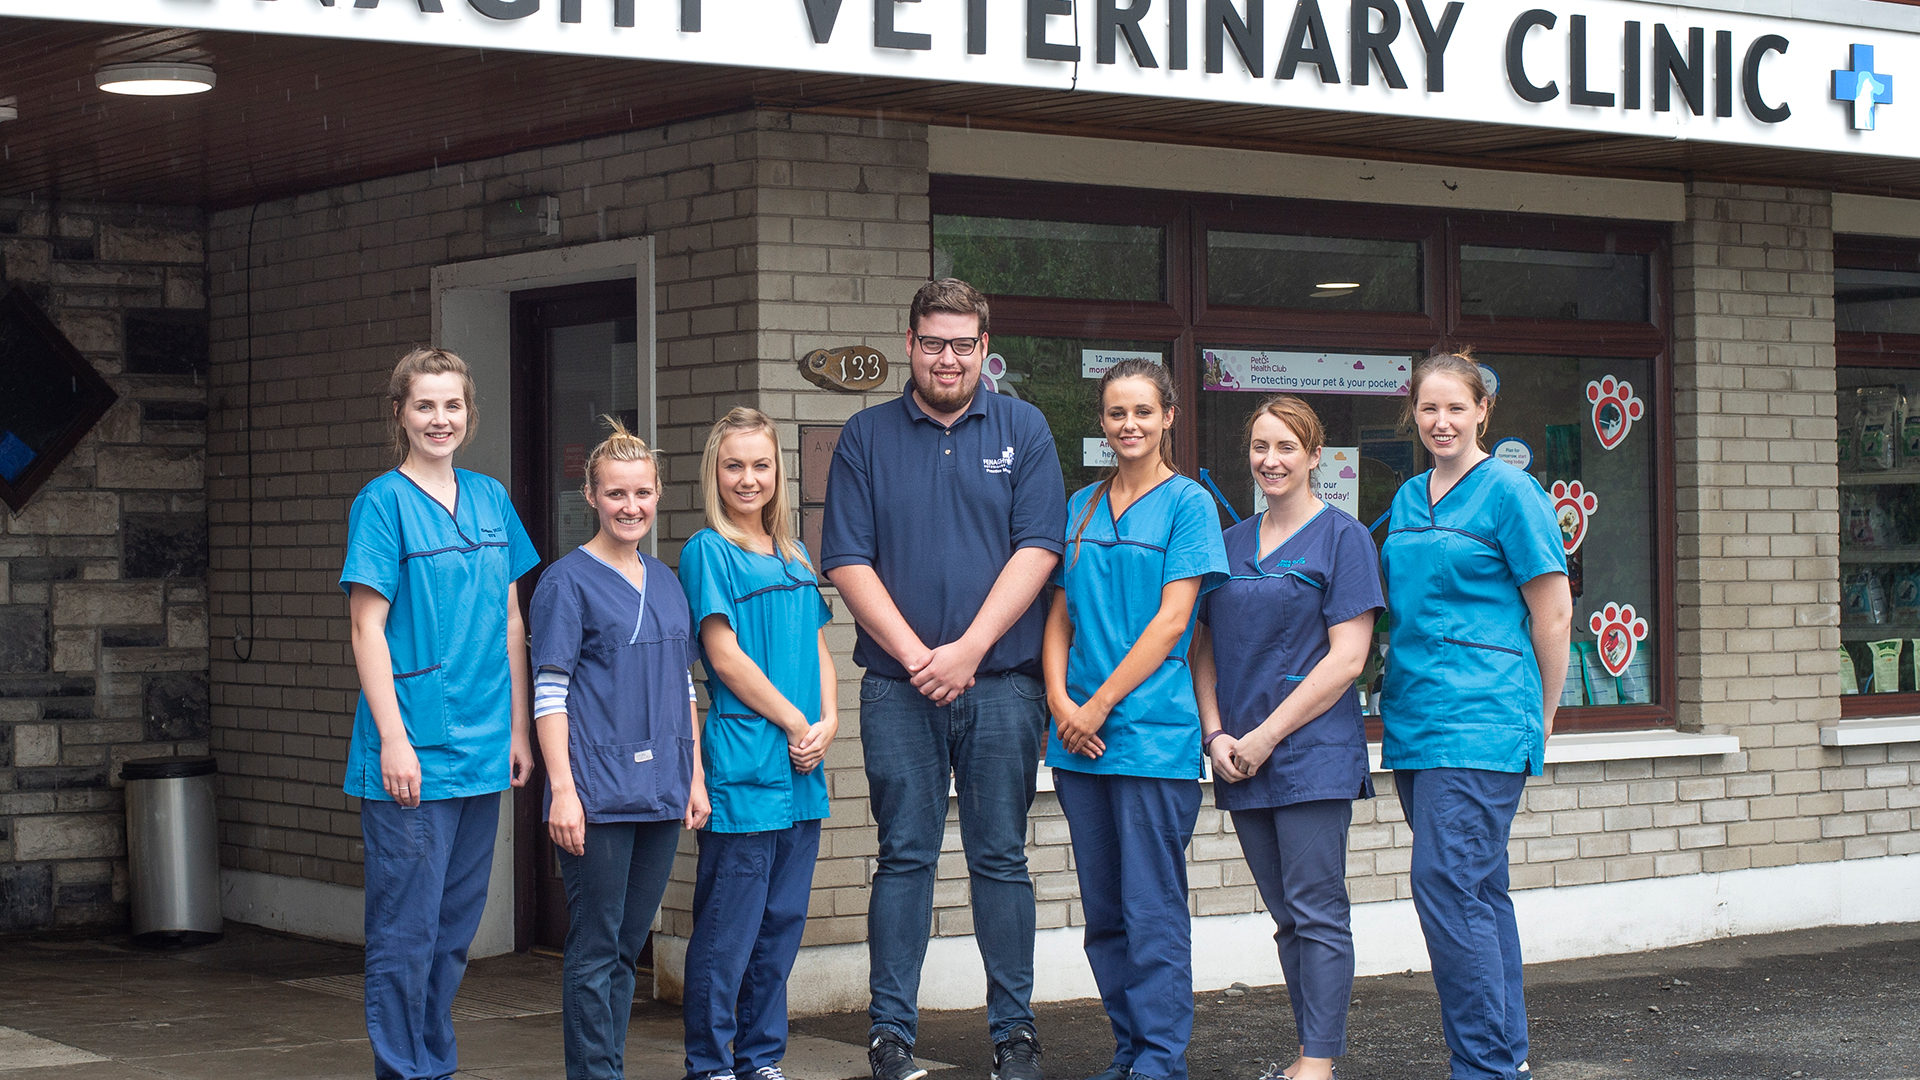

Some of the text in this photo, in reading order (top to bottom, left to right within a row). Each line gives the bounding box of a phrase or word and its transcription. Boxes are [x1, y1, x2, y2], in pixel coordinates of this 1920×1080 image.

[803, 0, 1792, 123] VETERINARY CLINIC
[1095, 355, 1103, 363] 12
[1250, 356, 1261, 364] Pet
[840, 354, 880, 382] 133
[1250, 364, 1287, 373] Health Club
[1251, 375, 1398, 389] Protecting your pet & your pocket
[815, 442, 822, 452] A
[1324, 491, 1350, 501] today!
